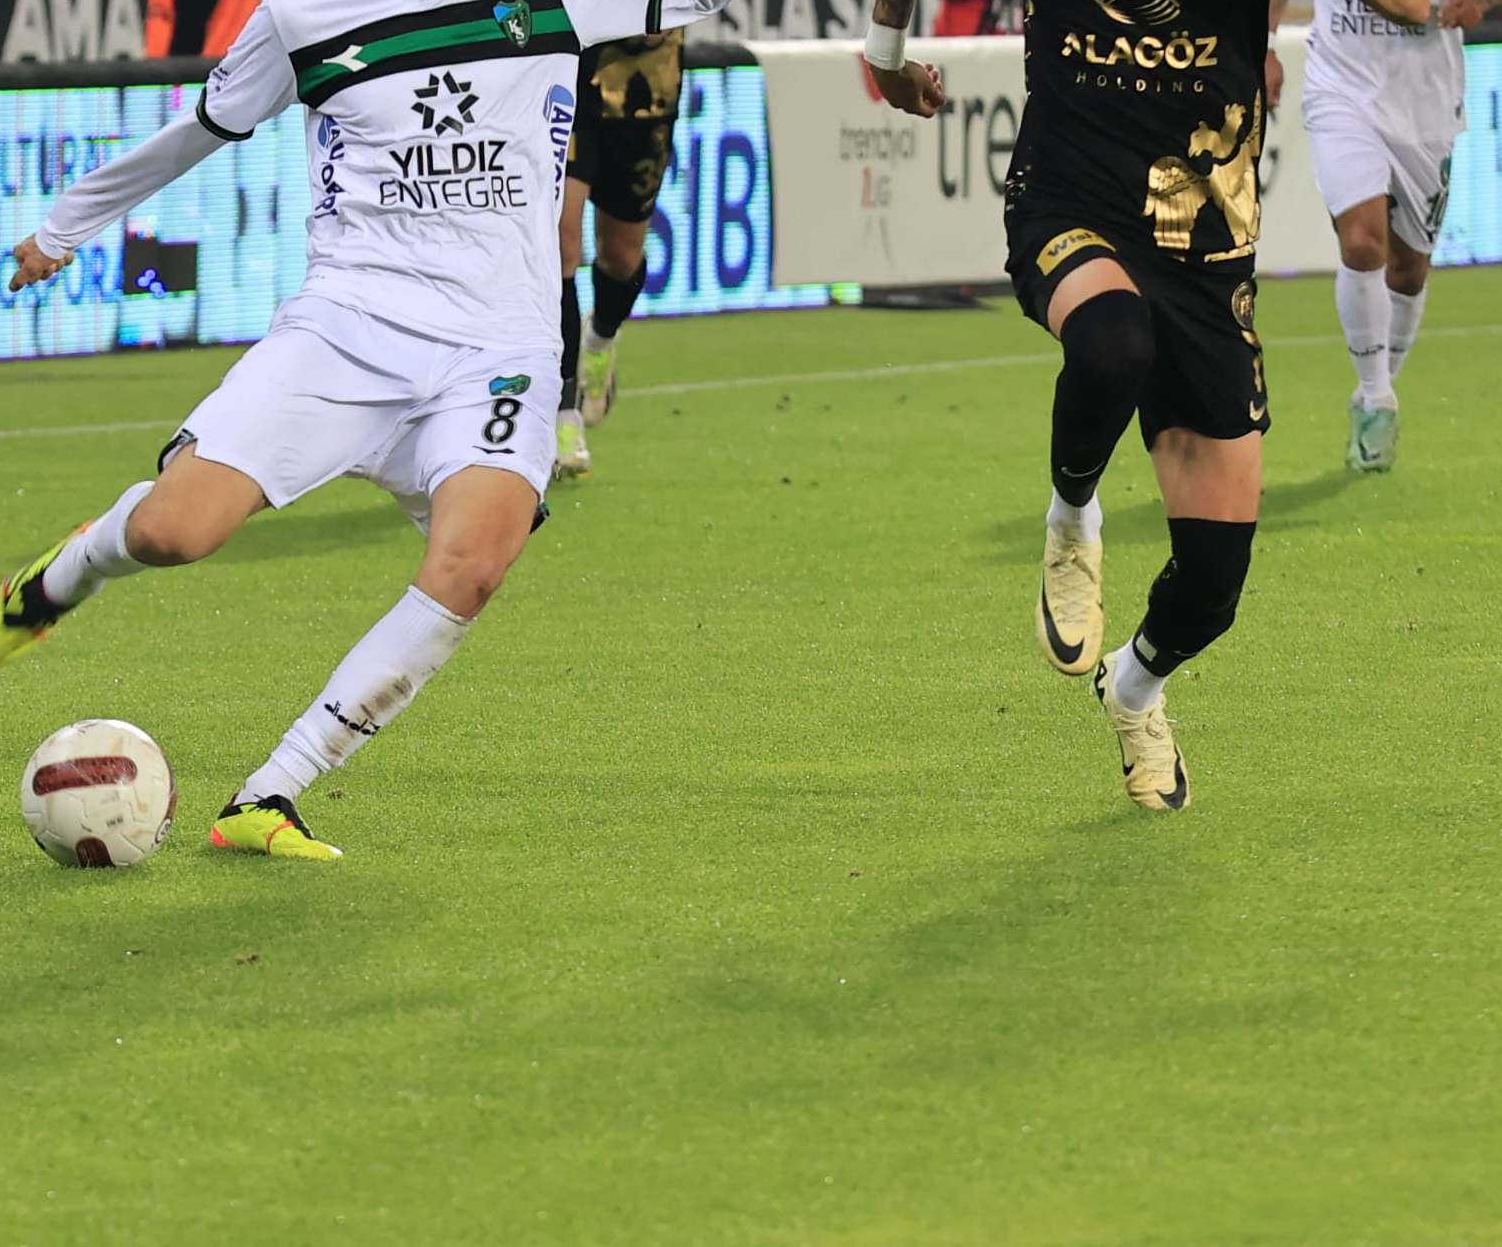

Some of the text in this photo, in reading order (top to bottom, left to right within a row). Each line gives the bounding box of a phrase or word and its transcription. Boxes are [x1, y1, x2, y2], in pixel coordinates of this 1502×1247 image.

[1061, 31, 1218, 69] ALAGÖZ
[1076, 71, 1204, 93] HOLDING
[388, 140, 508, 179] YILDIZ
[379, 174, 528, 210] ENTEGRE
[483, 397, 522, 444] 8
